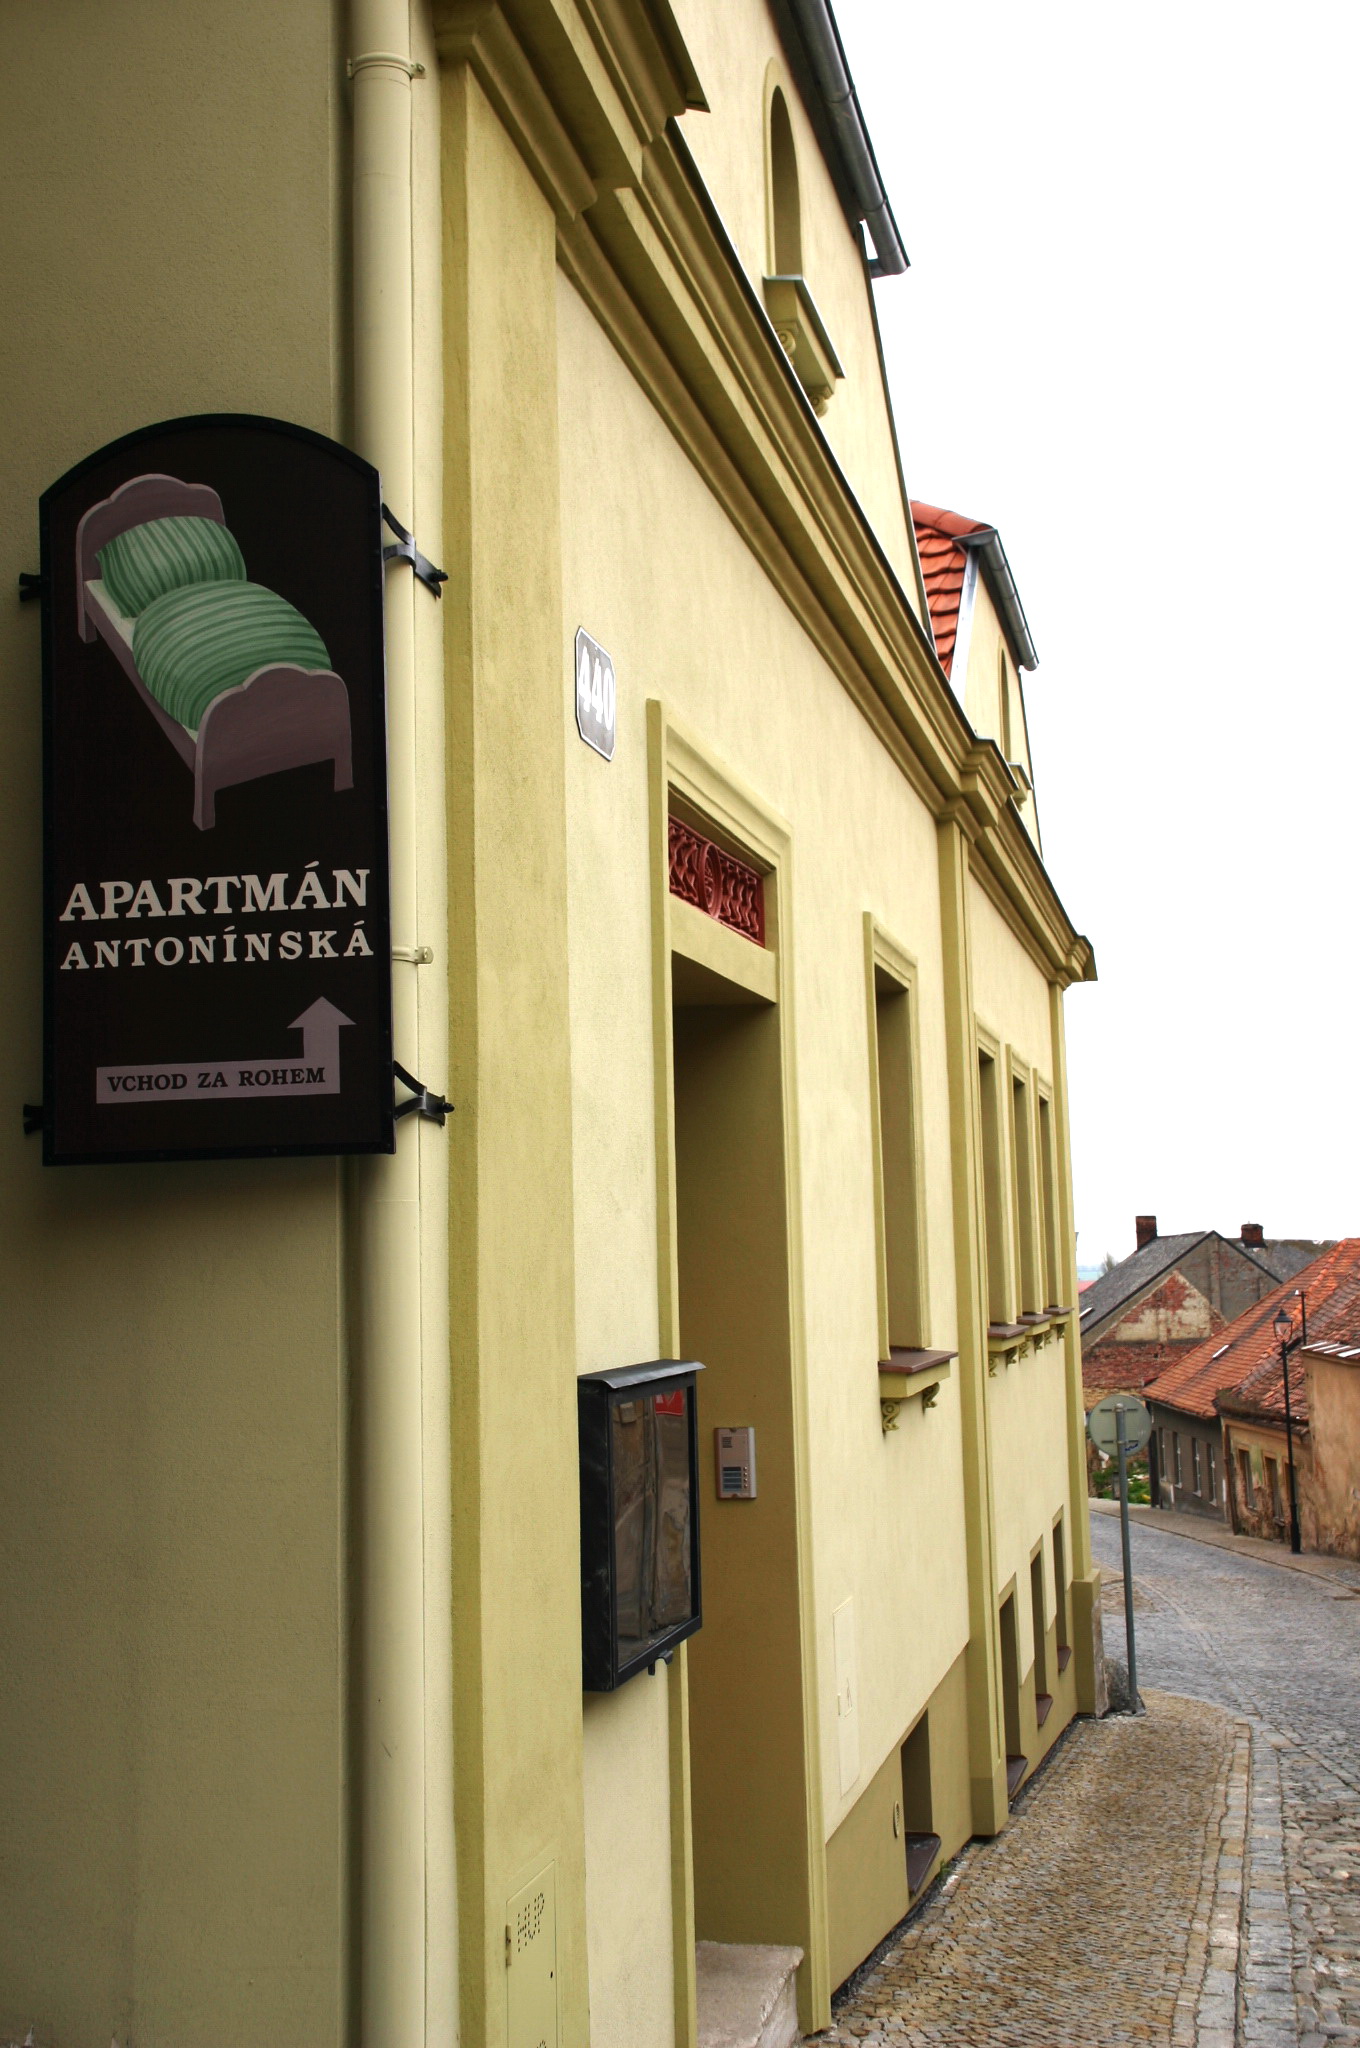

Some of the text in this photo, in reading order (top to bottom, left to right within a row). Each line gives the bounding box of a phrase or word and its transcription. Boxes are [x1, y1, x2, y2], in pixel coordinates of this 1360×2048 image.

[578, 645, 614, 731] 440
[59, 860, 370, 922] APARTMÁN
[60, 920, 374, 970] ANTONÍNSKÁ
[107, 1066, 326, 1092] VCHOD ZA ROHEM
